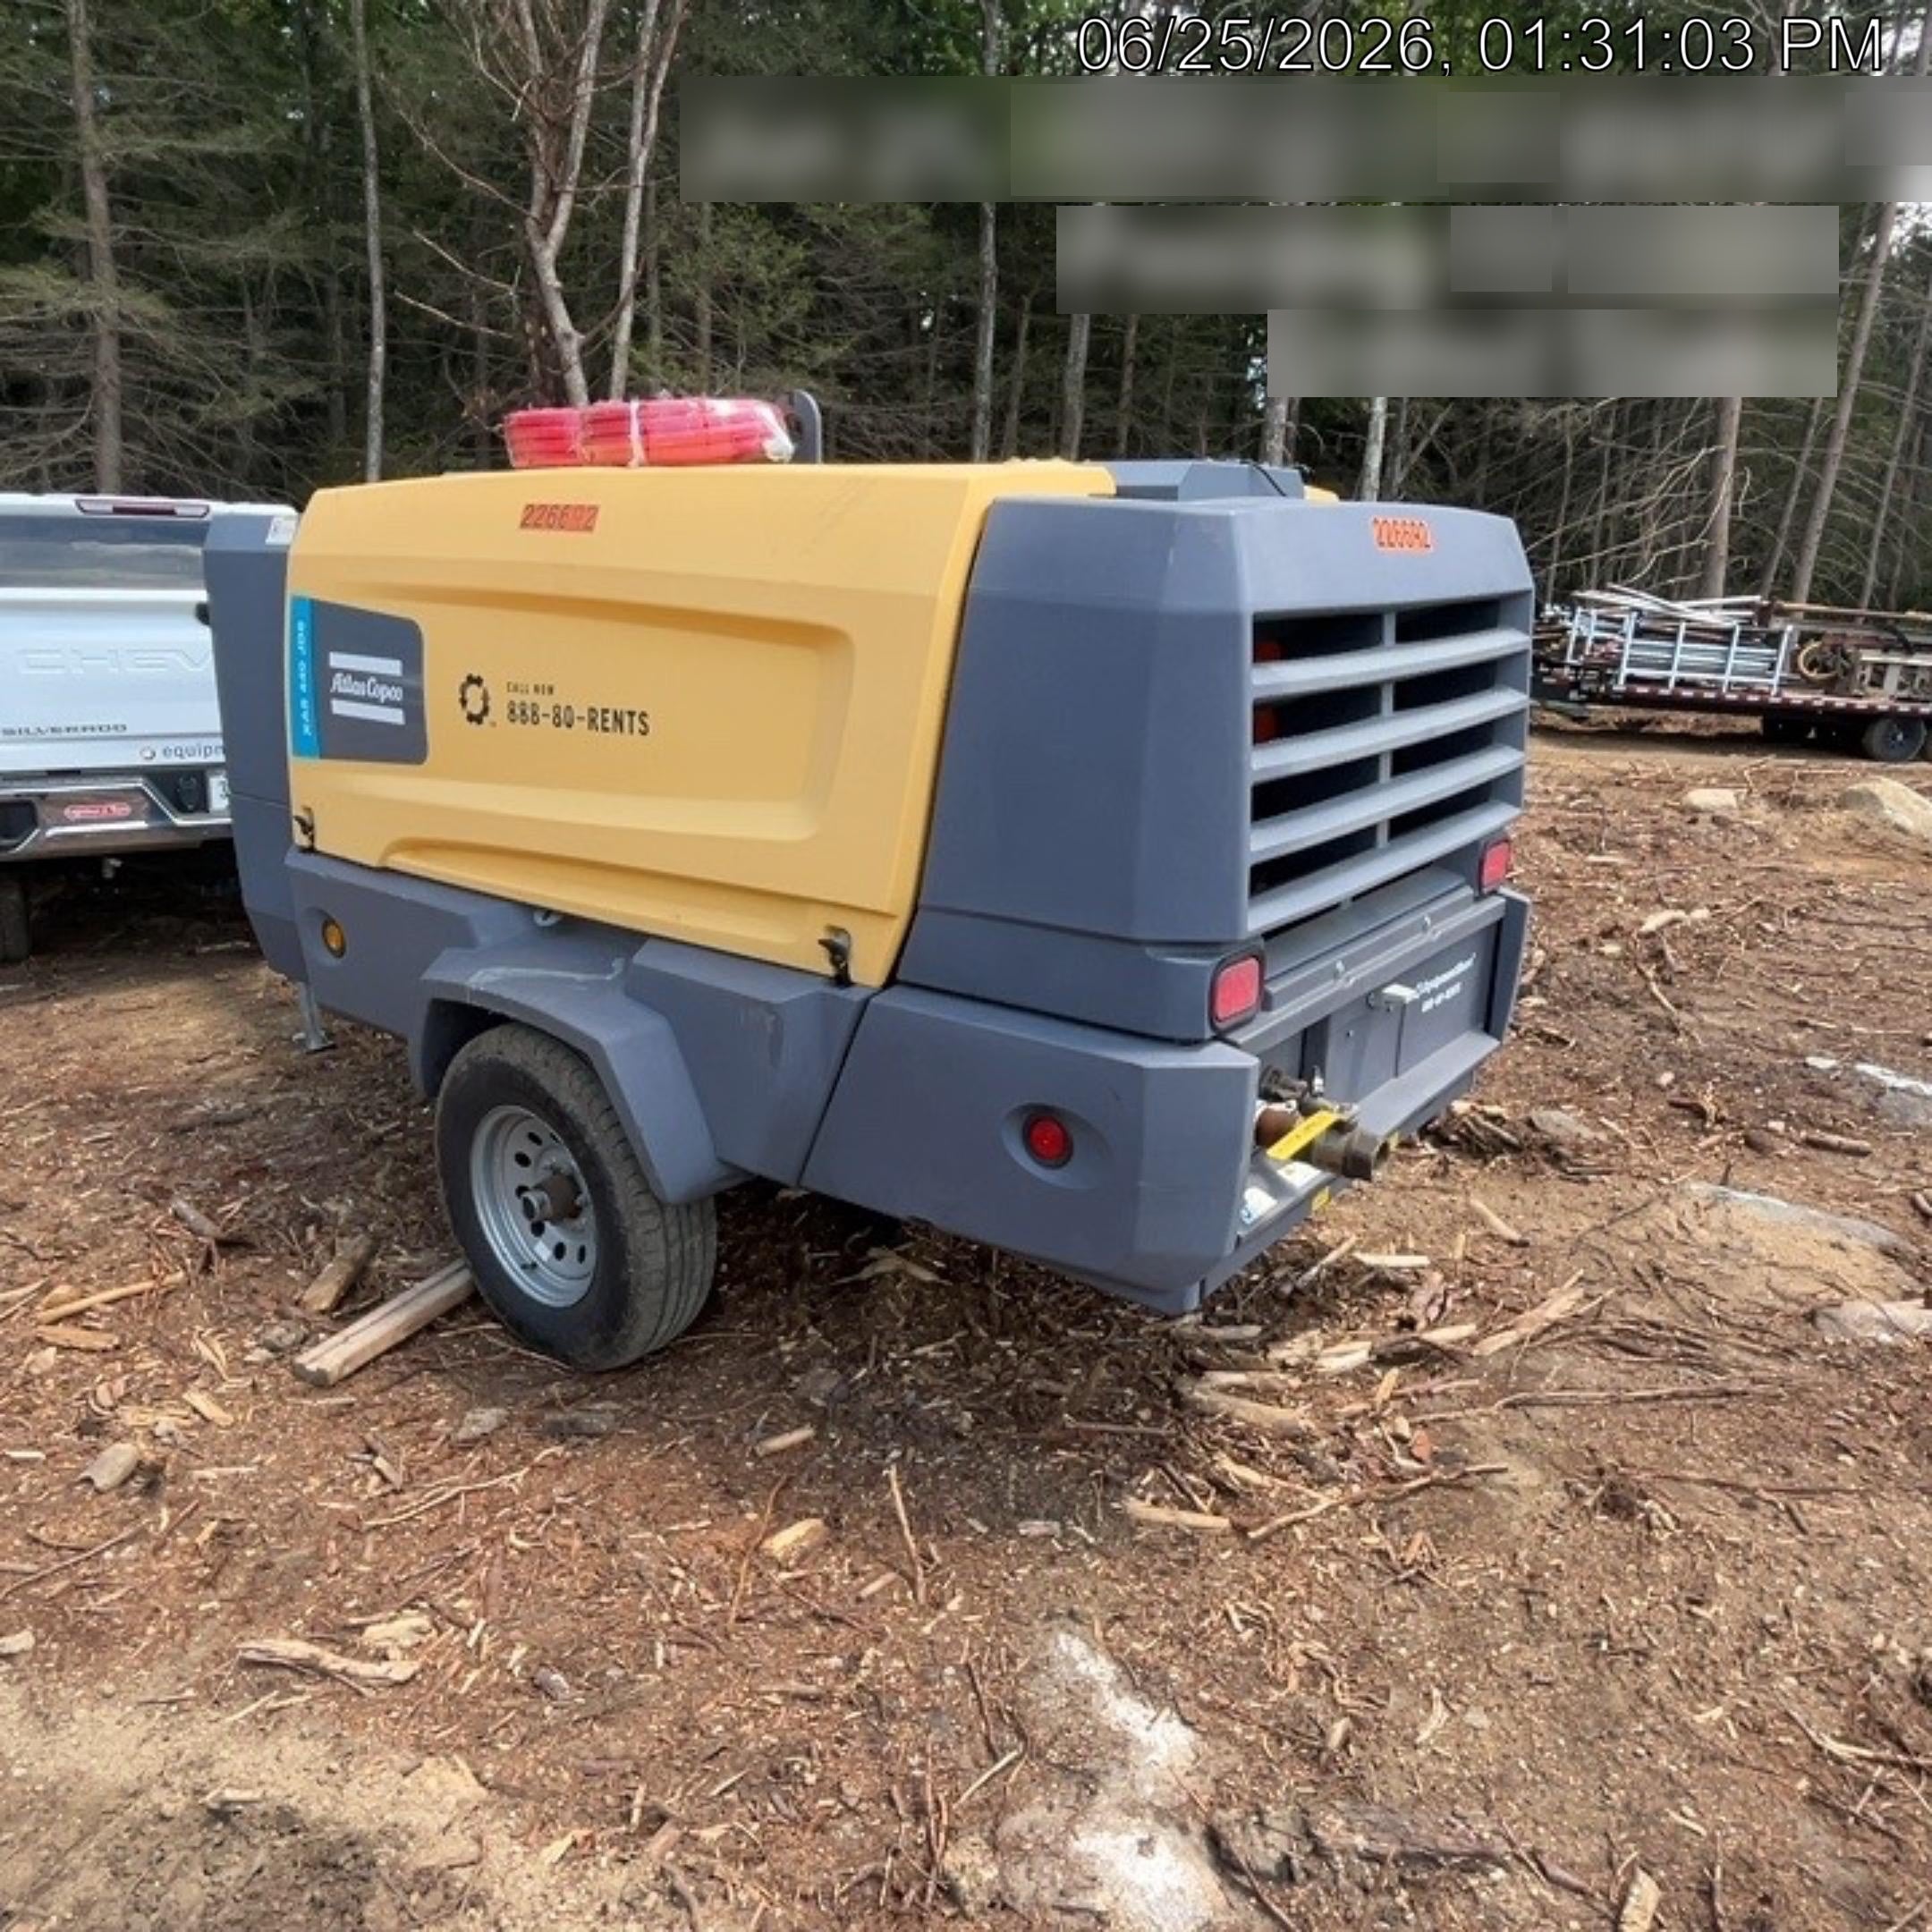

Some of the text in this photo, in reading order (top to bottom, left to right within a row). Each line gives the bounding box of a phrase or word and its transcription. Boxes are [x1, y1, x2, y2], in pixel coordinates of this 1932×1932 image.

[329, 673, 403, 704] Atlas Copco
[2, 723, 127, 737] SILVERADO
[506, 699, 650, 736] 888-80-RENTS
